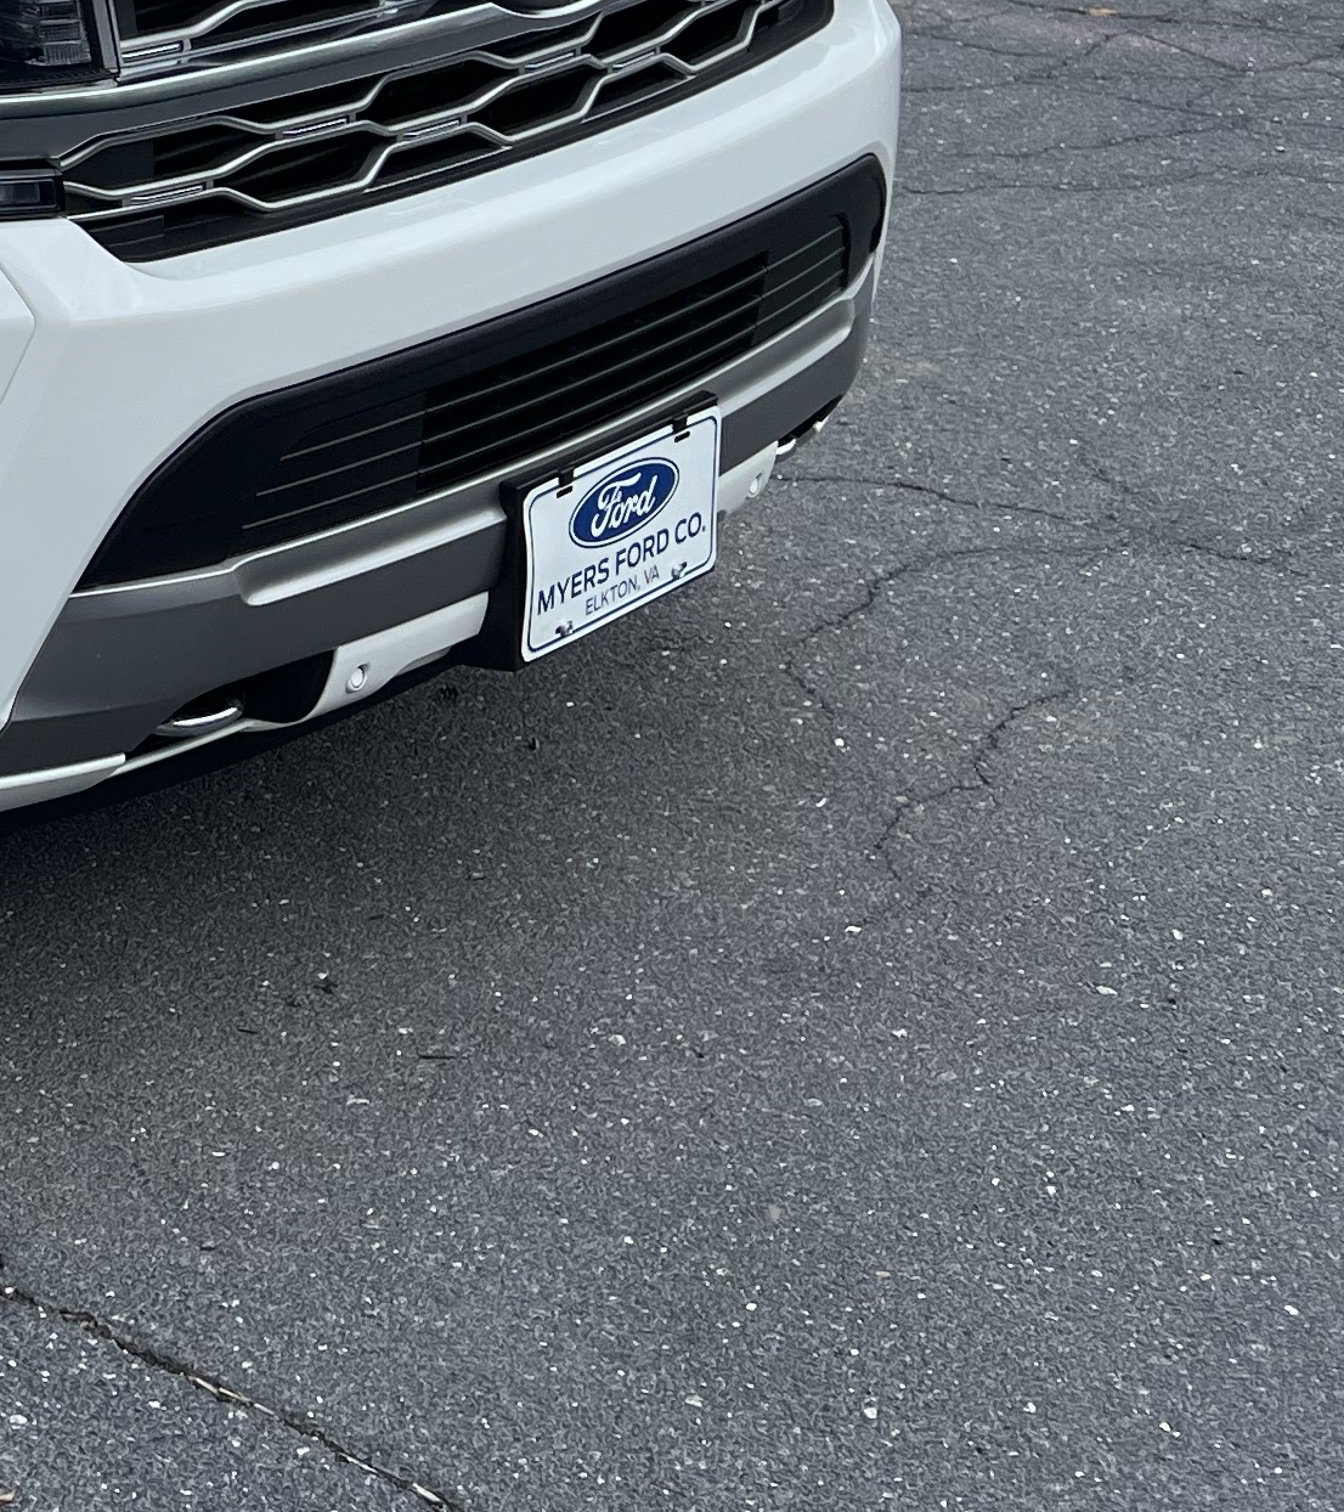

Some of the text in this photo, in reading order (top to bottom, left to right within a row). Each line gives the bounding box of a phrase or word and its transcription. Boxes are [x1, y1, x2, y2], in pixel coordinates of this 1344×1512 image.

[590, 472, 658, 538] Ford
[536, 511, 707, 617] MYERS FORD CO.
[640, 564, 661, 587] VA
